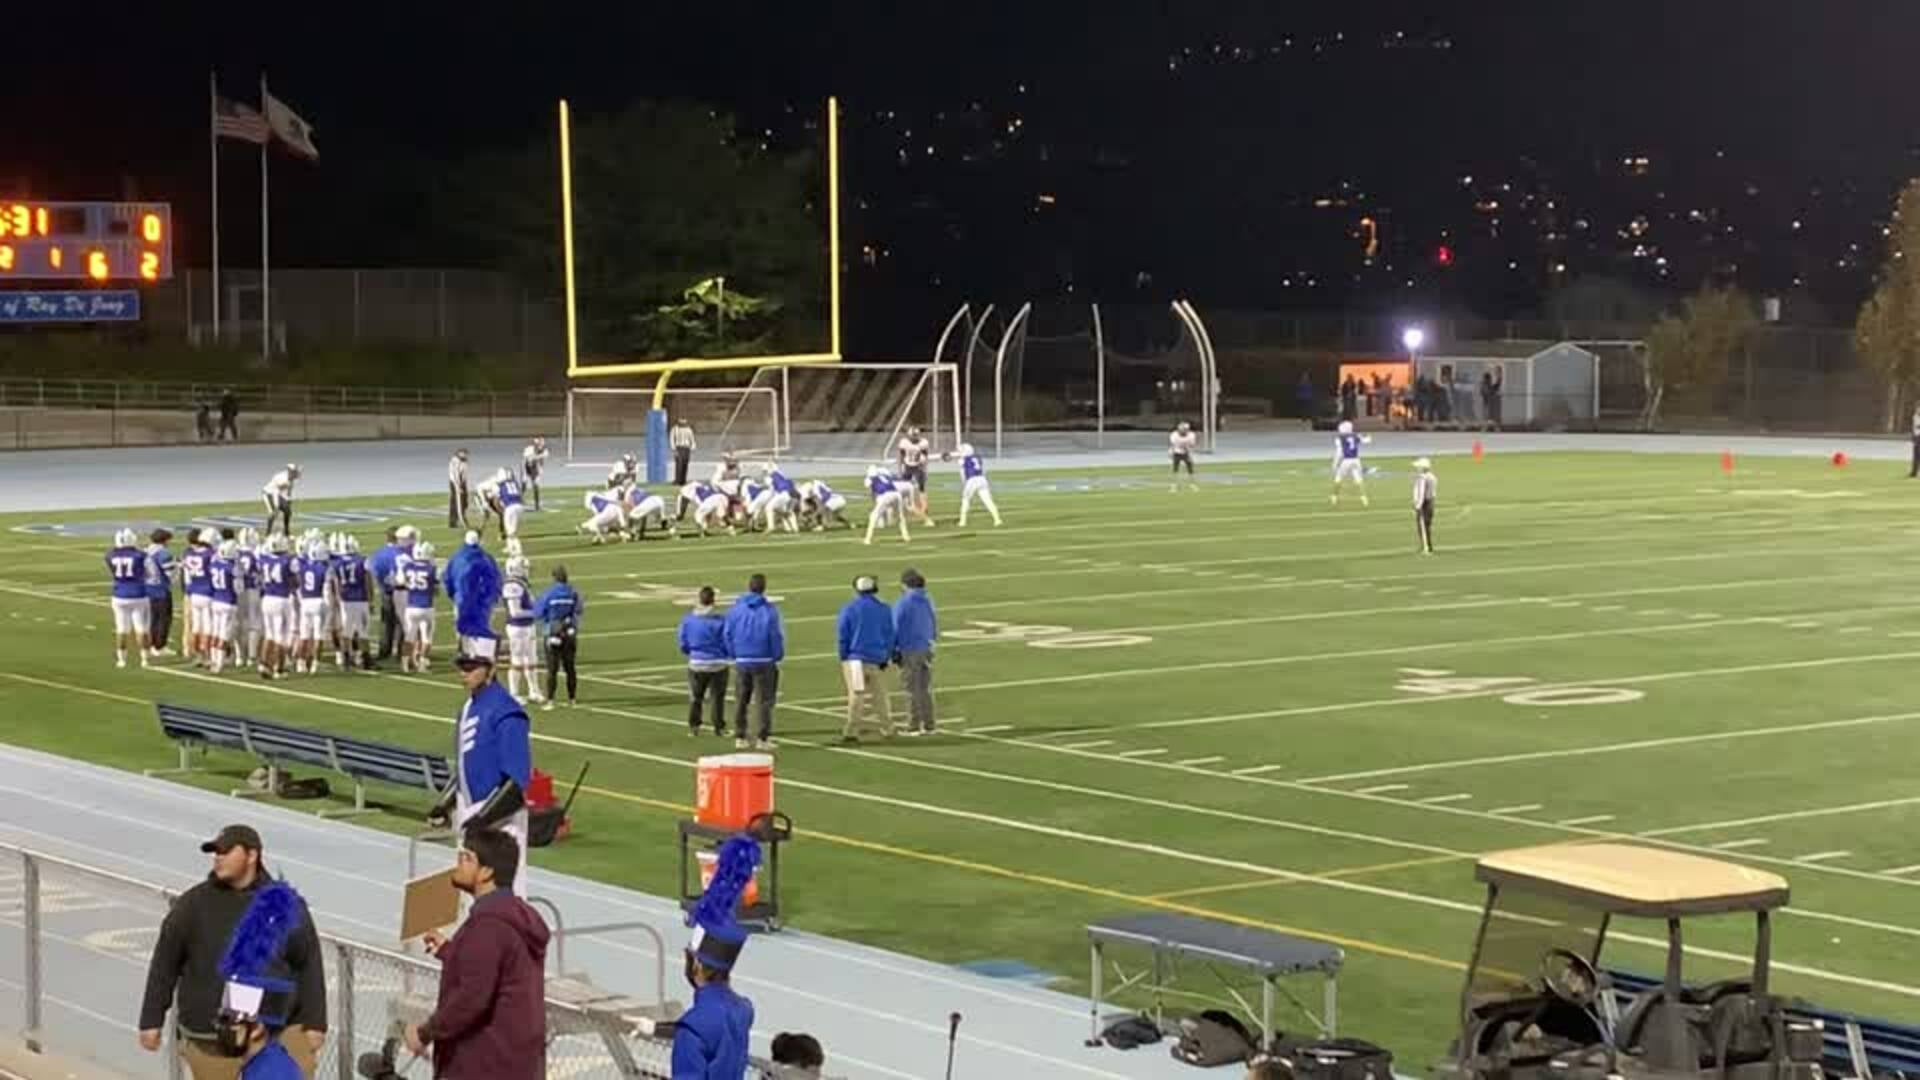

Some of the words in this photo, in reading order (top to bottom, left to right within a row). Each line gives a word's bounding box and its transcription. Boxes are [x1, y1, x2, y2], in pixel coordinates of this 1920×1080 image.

[143, 214, 161, 241] 0
[89, 252, 108, 279] 6
[141, 252, 158, 279] 2
[111, 557, 134, 577] 77
[262, 562, 283, 583] 14
[304, 571, 315, 592] 9
